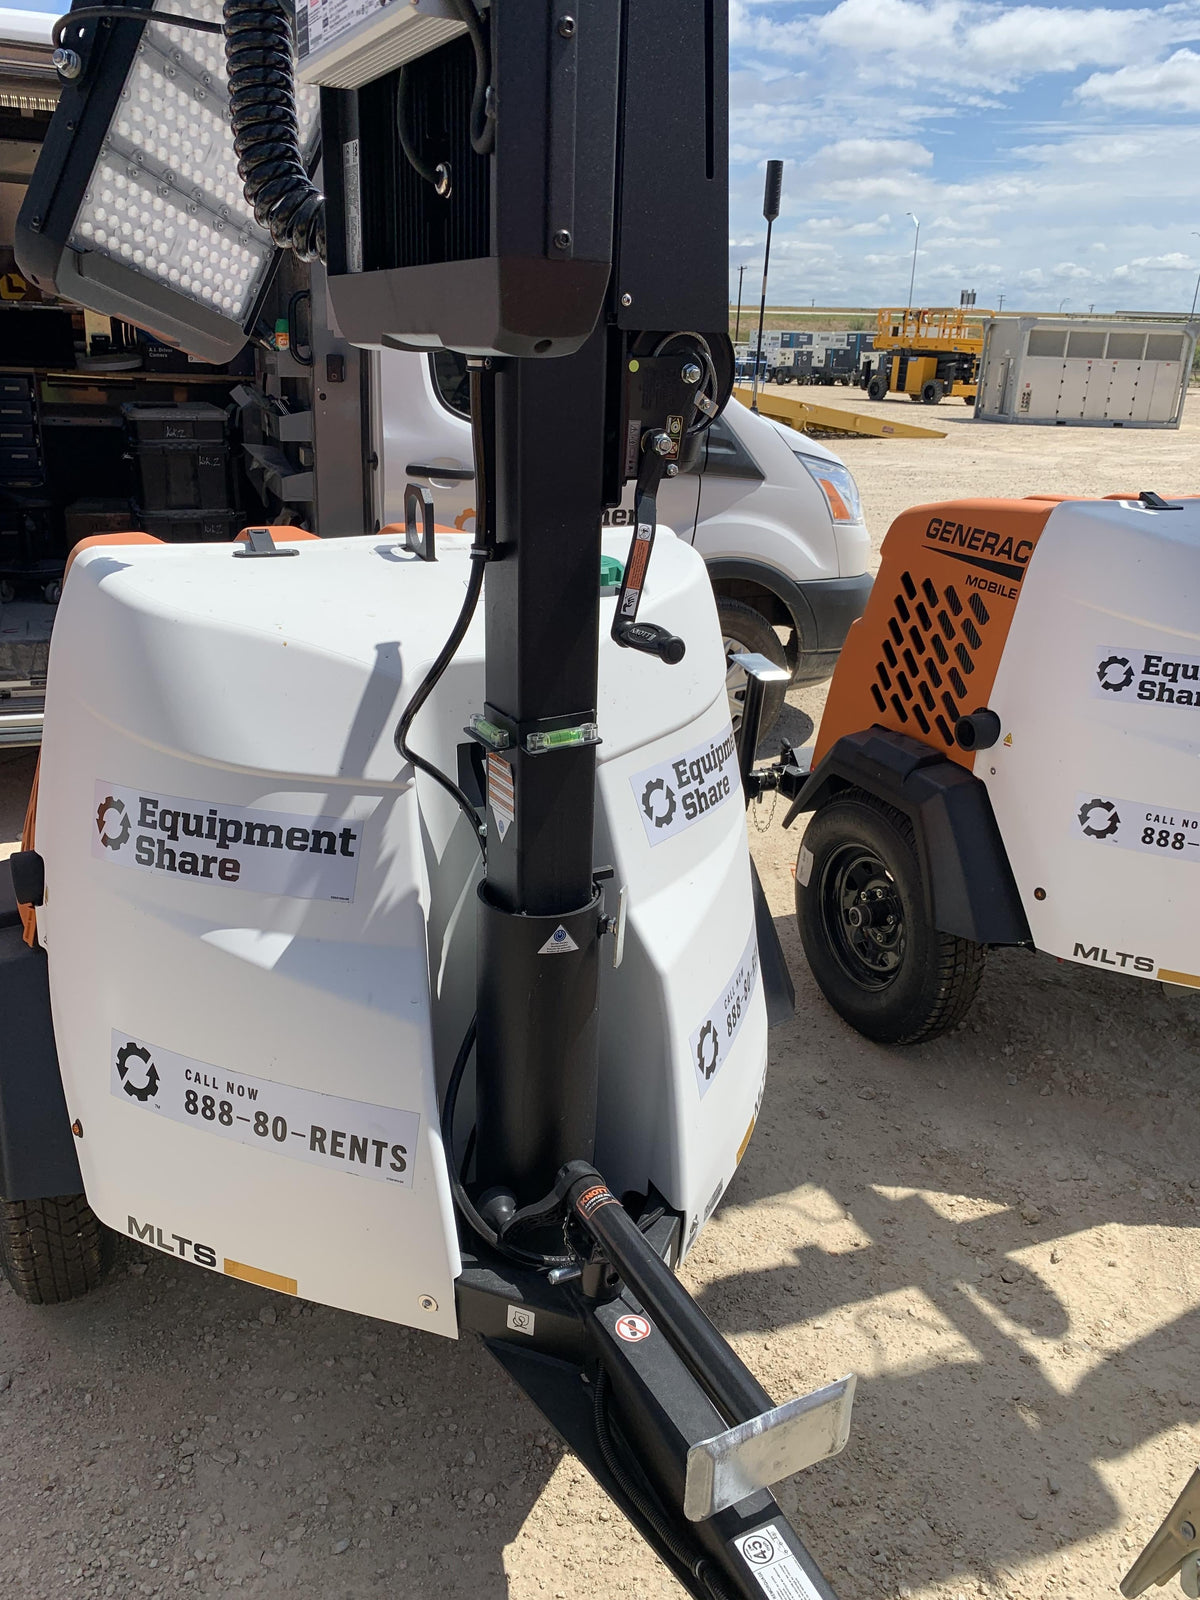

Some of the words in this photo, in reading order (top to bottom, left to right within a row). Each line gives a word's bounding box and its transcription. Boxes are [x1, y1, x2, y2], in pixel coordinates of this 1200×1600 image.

[926, 518, 1033, 564] GENERAC
[965, 575, 1018, 600] MOBILE
[681, 775, 731, 821] Share
[1145, 813, 1175, 826] CALL
[137, 796, 357, 857] Equipment
[135, 834, 241, 882] Share
[1073, 942, 1155, 973] MLTS
[184, 1069, 219, 1090] CALL
[226, 1081, 259, 1101] NOW
[184, 1089, 407, 1173] 888-80-RENTS
[127, 1215, 217, 1267] MLTS
[747, 1540, 767, 1560] 45
